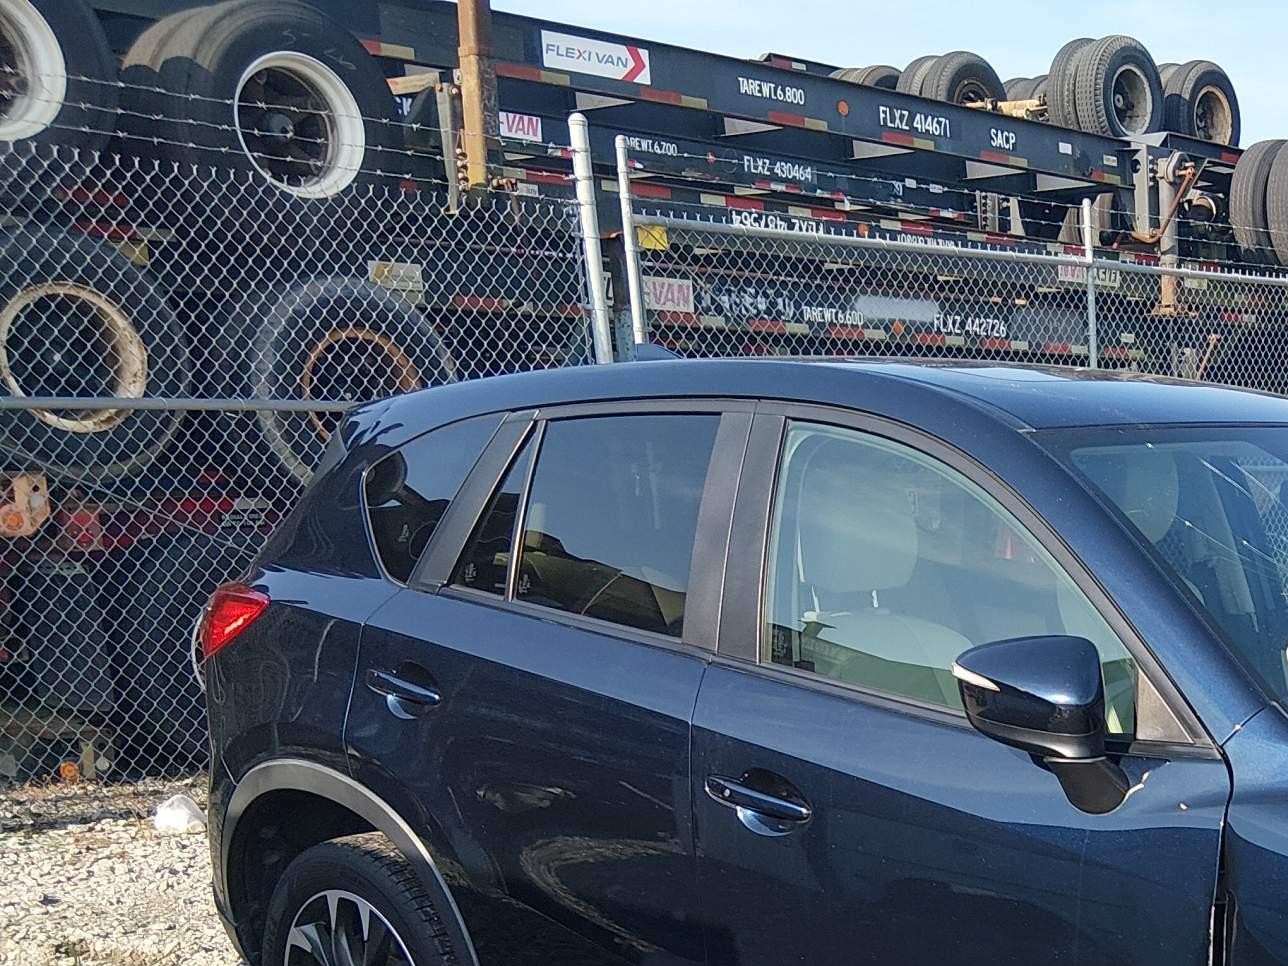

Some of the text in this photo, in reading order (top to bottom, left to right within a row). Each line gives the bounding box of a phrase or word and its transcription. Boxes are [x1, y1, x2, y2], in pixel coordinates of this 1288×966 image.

[545, 43, 629, 68] FLEXI VAN
[879, 106, 950, 137] FLXZ 414671
[990, 128, 1016, 151] SACP
[743, 155, 812, 182] FLXZ 430464
[934, 313, 1007, 338] FLXZ 442726
